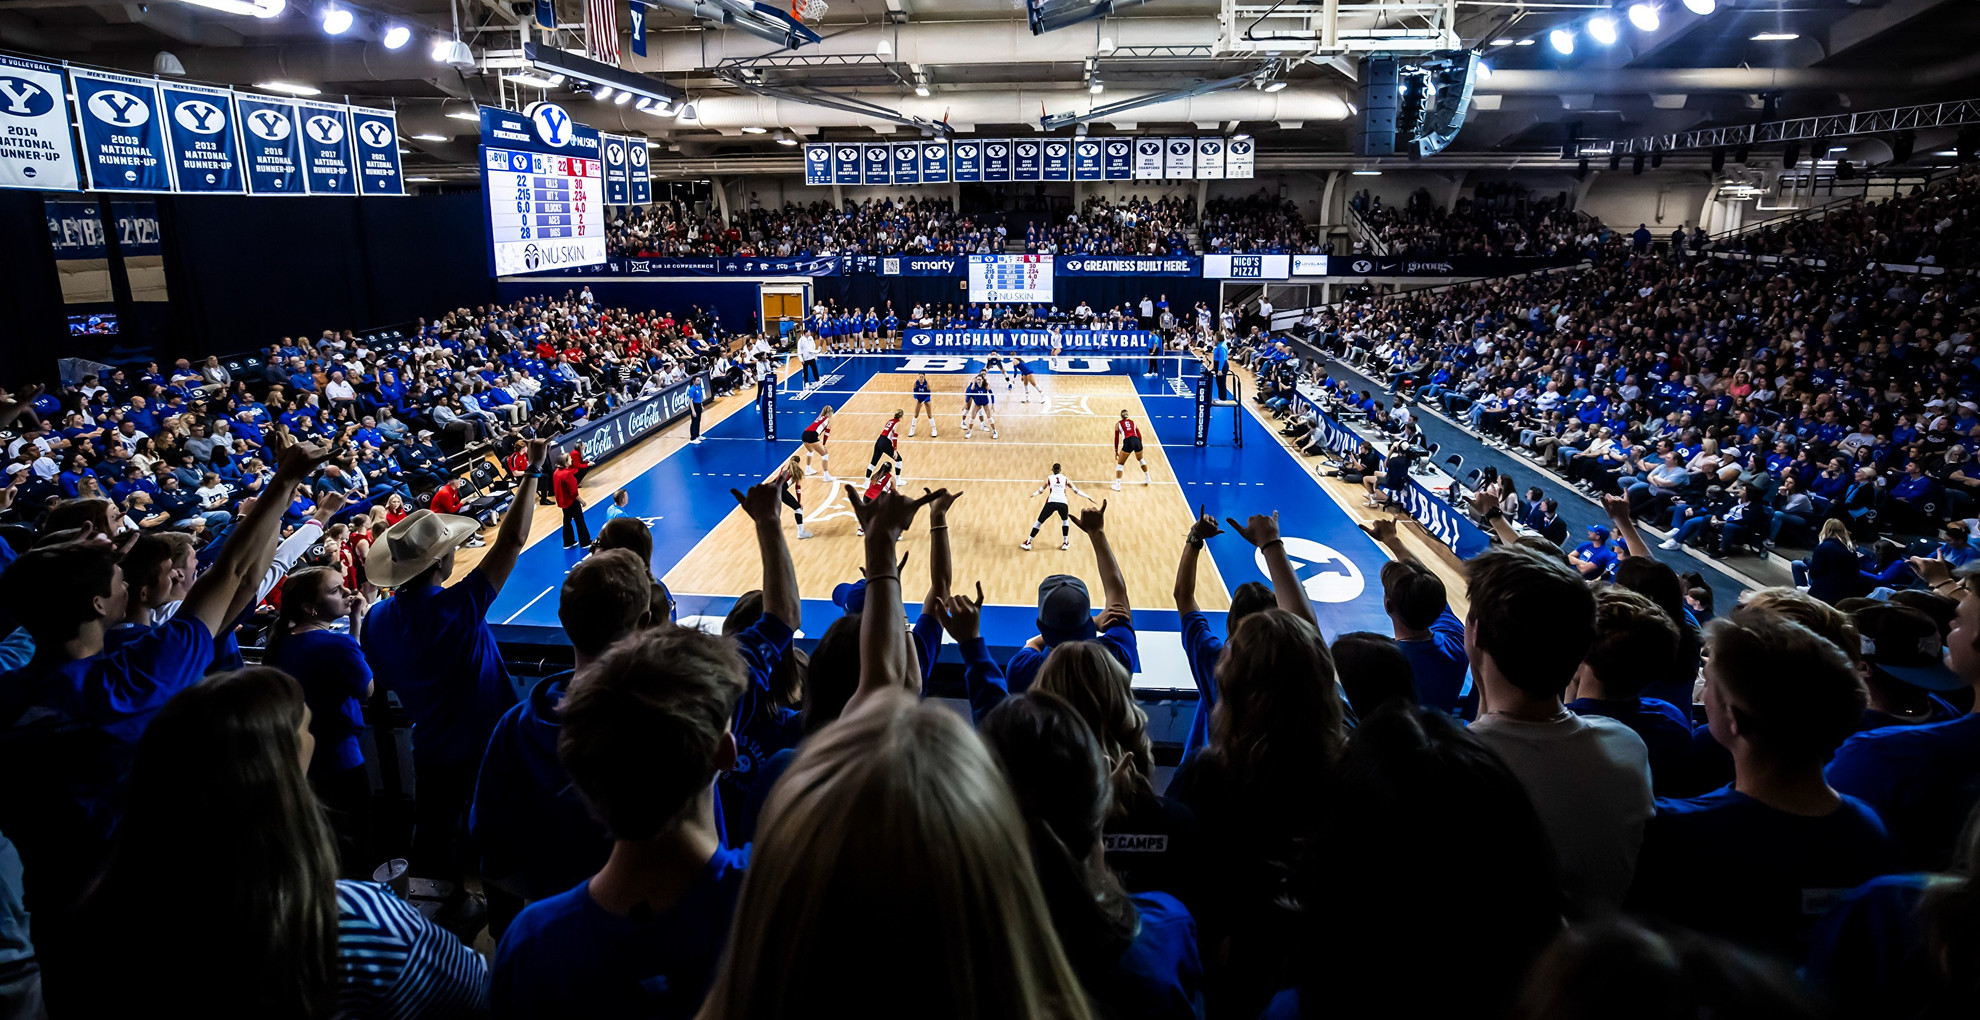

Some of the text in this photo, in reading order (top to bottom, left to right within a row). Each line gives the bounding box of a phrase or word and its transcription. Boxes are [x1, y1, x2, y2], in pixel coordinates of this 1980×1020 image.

[631, 11, 643, 40] Y
[9, 59, 51, 72] VOLLEYBALL
[108, 74, 142, 84] VOLLEYBALL
[98, 94, 139, 123] Y
[183, 104, 216, 130] Y
[255, 113, 283, 137] Y
[313, 119, 336, 140] Y
[541, 108, 567, 144] Y
[8, 126, 38, 137] 2014
[365, 124, 385, 144] Y
[111, 135, 138, 144] 2003
[101, 144, 152, 156] NATIONAL
[195, 142, 216, 150] 2013
[0, 148, 60, 161] UNNER-UP
[185, 151, 228, 160] NATIONAL
[494, 152, 506, 162] BYU
[99, 155, 157, 166] RUNNER-UP
[184, 160, 232, 170] RUNNER-UP
[256, 156, 292, 165] NATIONAL
[534, 158, 542, 169] 18
[256, 165, 295, 173] RUNNER-UP
[313, 167, 347, 175] RUNNER-UP
[558, 161, 566, 172] 22
[517, 175, 526, 187] 22
[575, 179, 583, 189] 30
[515, 189, 530, 200] .215
[572, 191, 587, 201] .234
[517, 202, 530, 213] 6.0
[545, 203, 562, 212] BLOCKS
[575, 203, 586, 213] 4.0
[522, 215, 527, 226] 0
[579, 214, 583, 224] 2
[521, 228, 530, 239] 28
[578, 226, 586, 236] 27
[542, 246, 585, 264] NU SKIN
[911, 260, 954, 273] smarty
[1084, 260, 1136, 272] GREATNESS
[1136, 261, 1162, 272] BUILT
[1164, 261, 1190, 272] HERE.
[1234, 257, 1259, 266] NICO'S
[1233, 267, 1259, 276] PIZZA
[935, 333, 1004, 346] BRIGHAM
[1065, 334, 1151, 346] VOLLEYBAL
[628, 401, 659, 436] Coca-Cola
[1119, 836, 1164, 849] CAMPS
